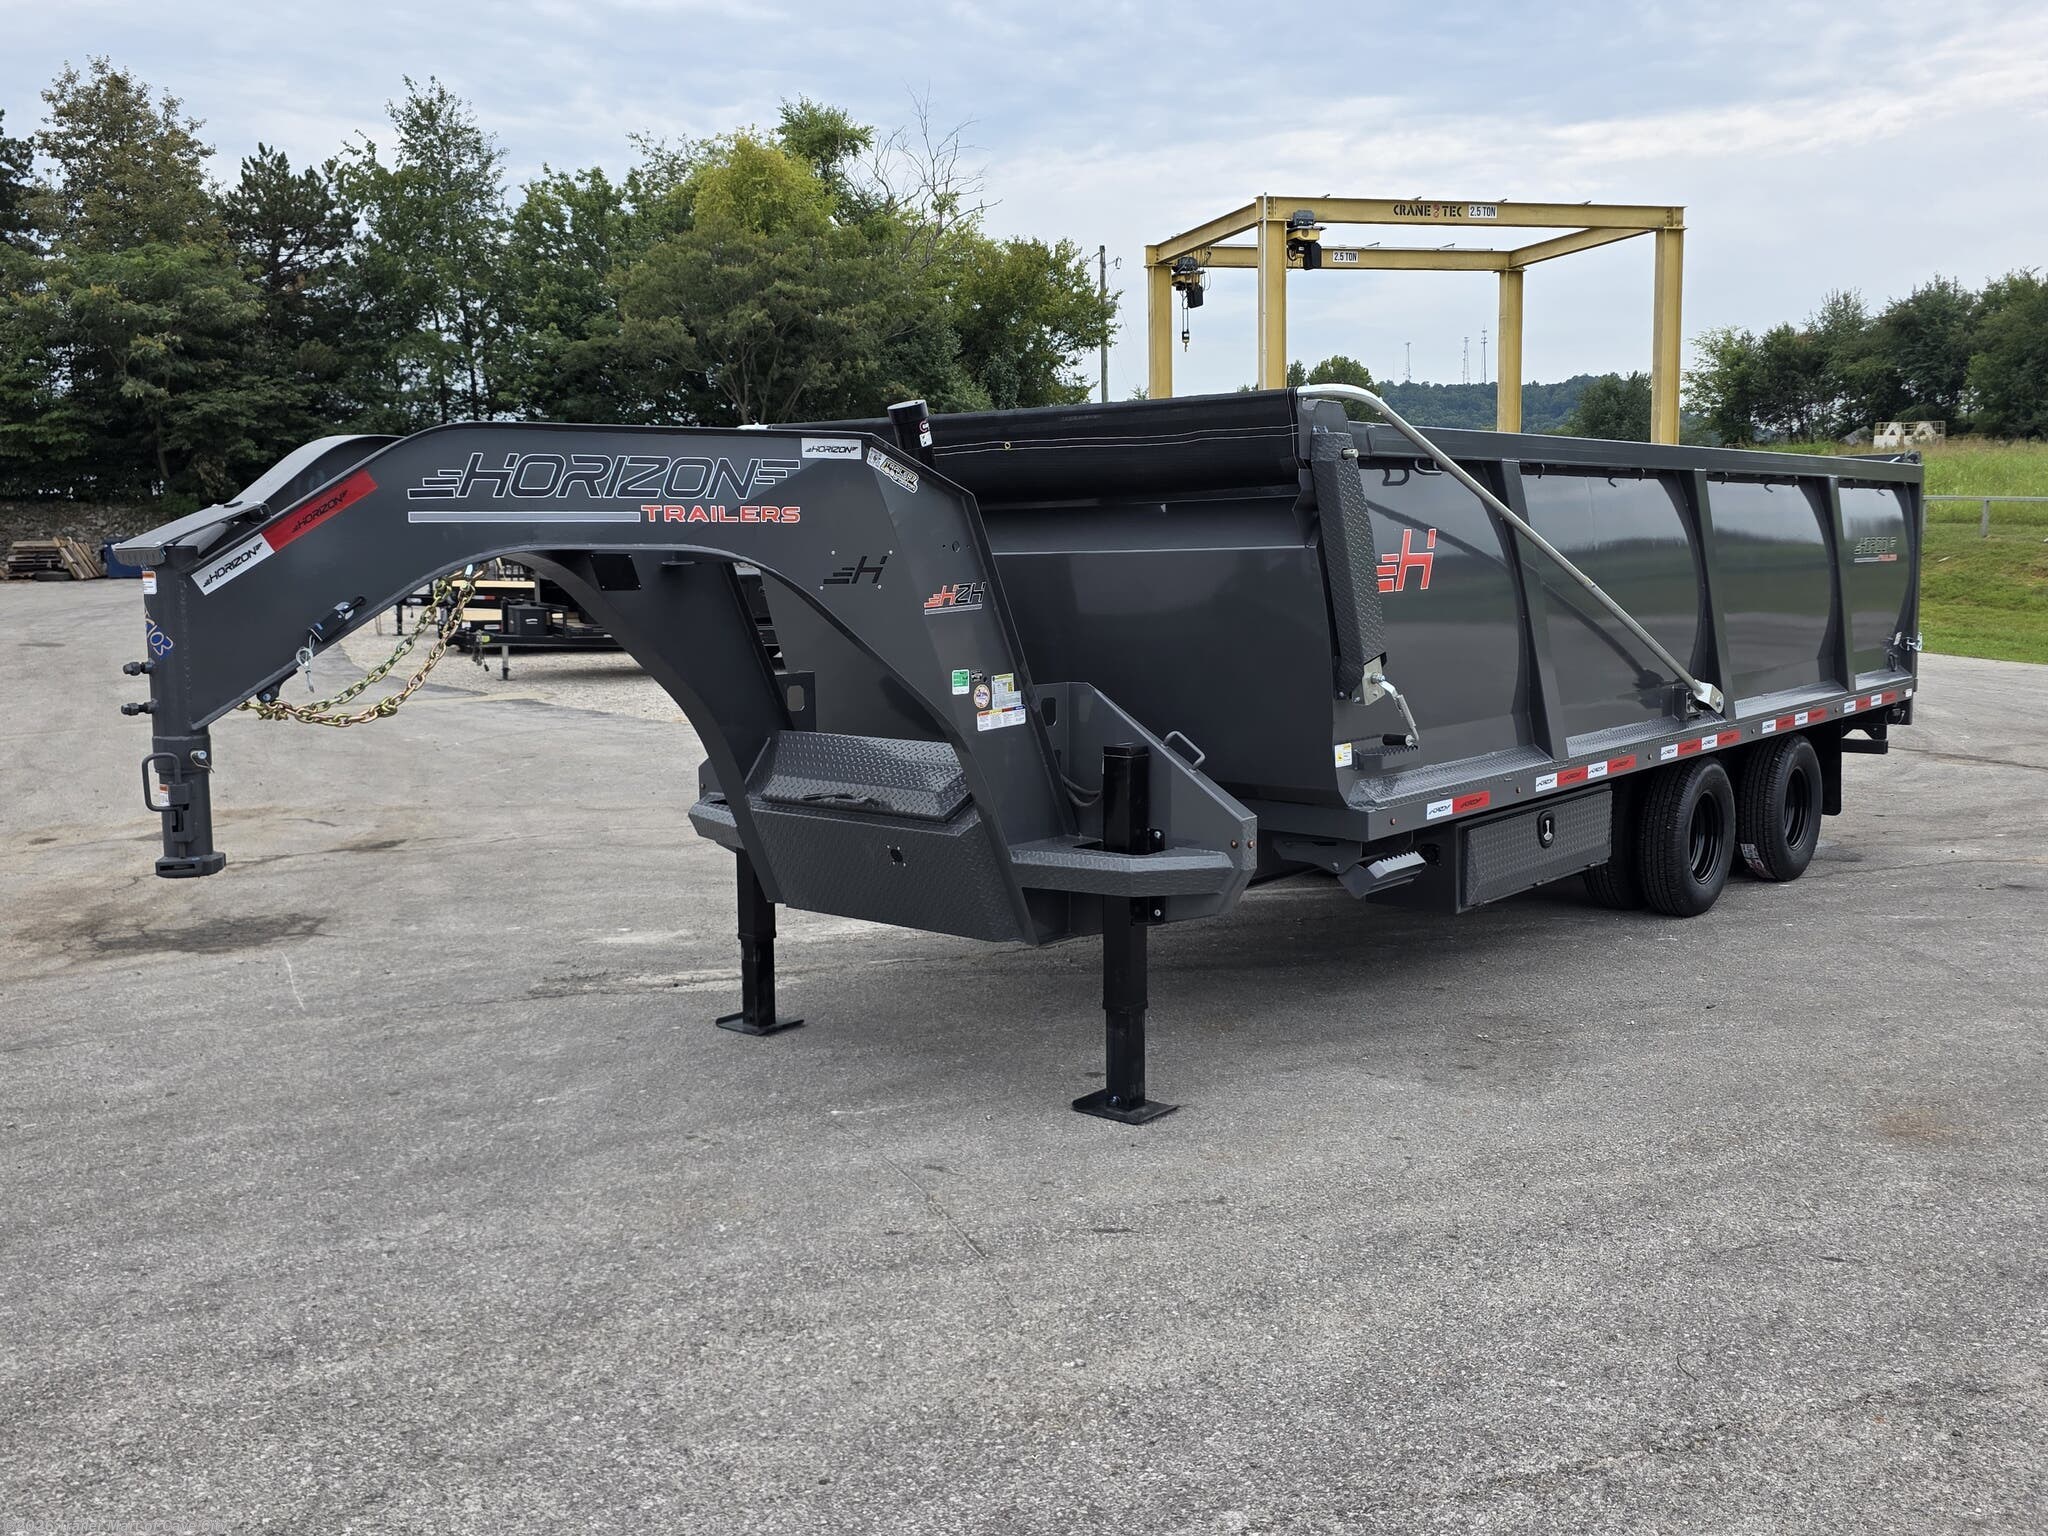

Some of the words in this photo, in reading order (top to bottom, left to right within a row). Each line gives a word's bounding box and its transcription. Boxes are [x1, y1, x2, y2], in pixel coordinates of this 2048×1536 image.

[1393, 204, 1431, 217] CRANE
[1441, 205, 1462, 217] TEC
[1470, 206, 1481, 217] 2.5
[1483, 206, 1496, 217] TON
[1334, 251, 1344, 261] 2.5
[1345, 252, 1357, 261] TON
[811, 445, 853, 454] HORIZON
[456, 452, 759, 500] HORIZON
[296, 493, 344, 530] HORIZON
[640, 504, 801, 523] TRAILERS
[208, 545, 259, 584] HORIZON
